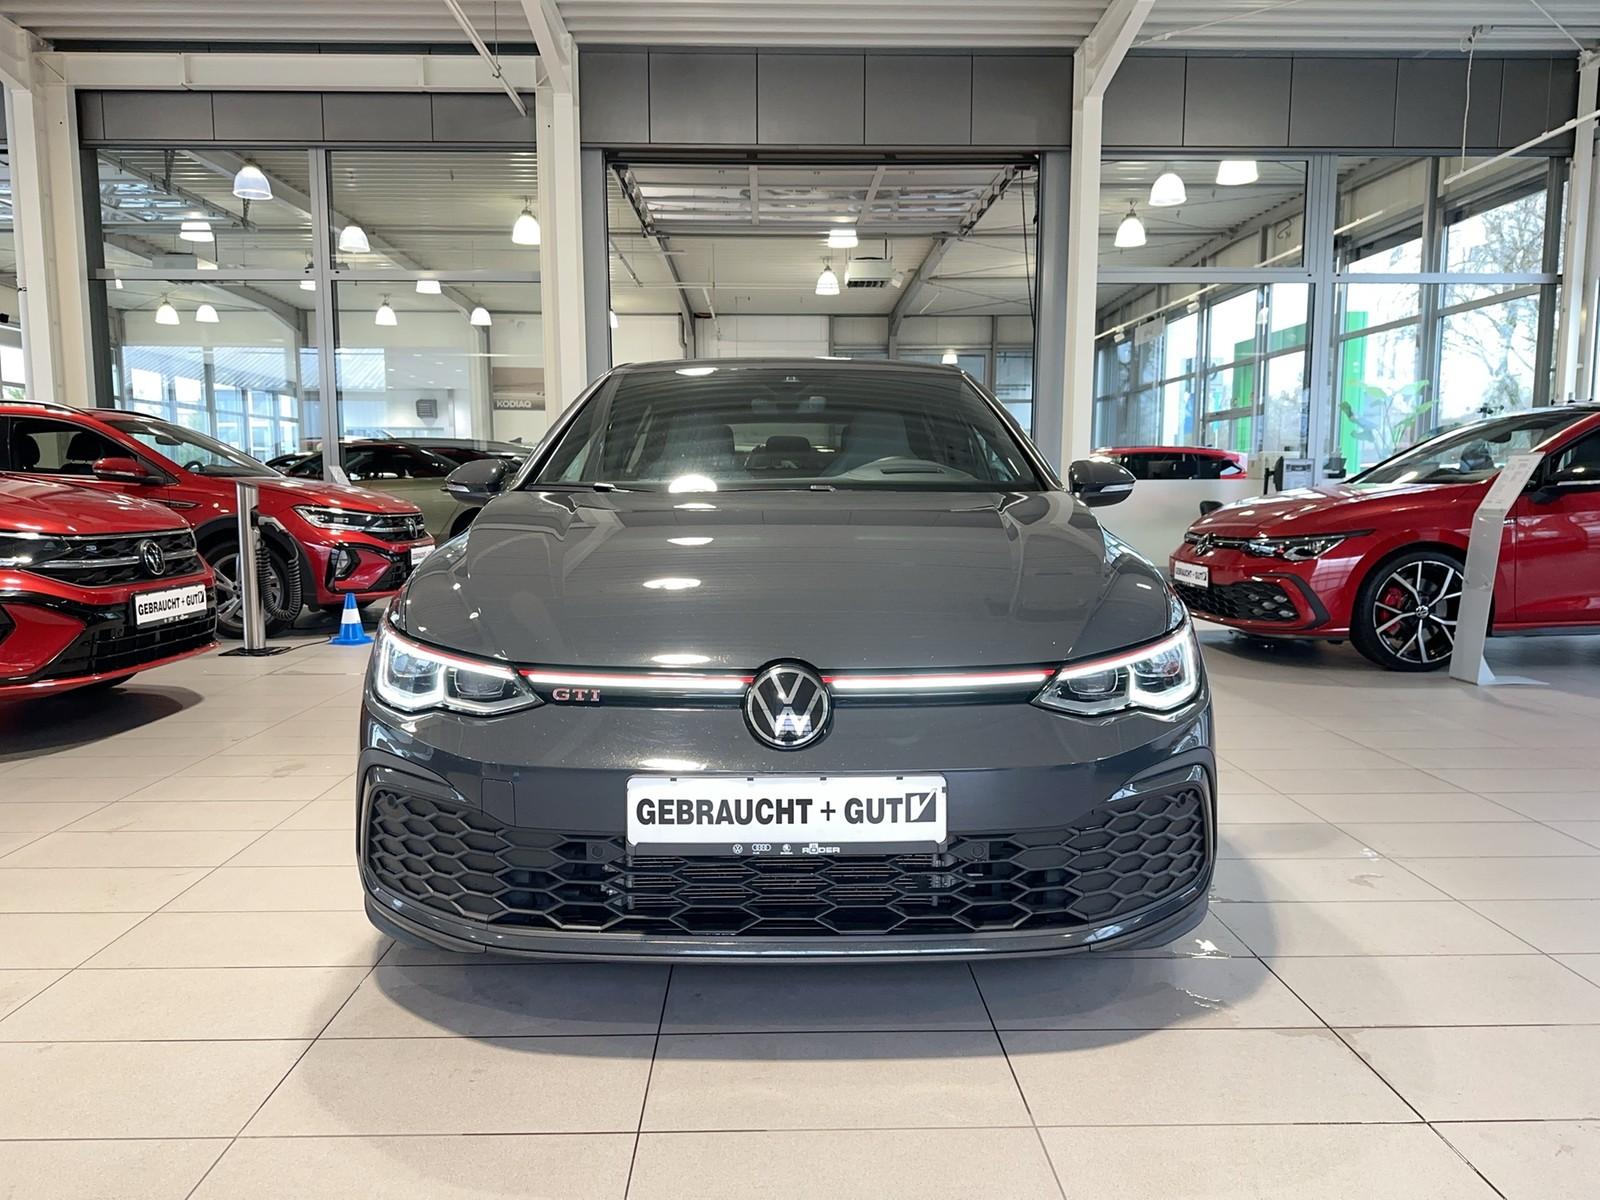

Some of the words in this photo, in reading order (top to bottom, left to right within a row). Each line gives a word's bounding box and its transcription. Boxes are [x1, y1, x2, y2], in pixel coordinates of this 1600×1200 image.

[496, 400, 532, 408] KODIAQ
[138, 597, 180, 616] GEBRAUCHT
[186, 594, 199, 606] GUT
[552, 688, 600, 702] GTI
[636, 798, 813, 825] GEBRAUCHT
[820, 801, 836, 822] +
[844, 797, 903, 825] GUT
